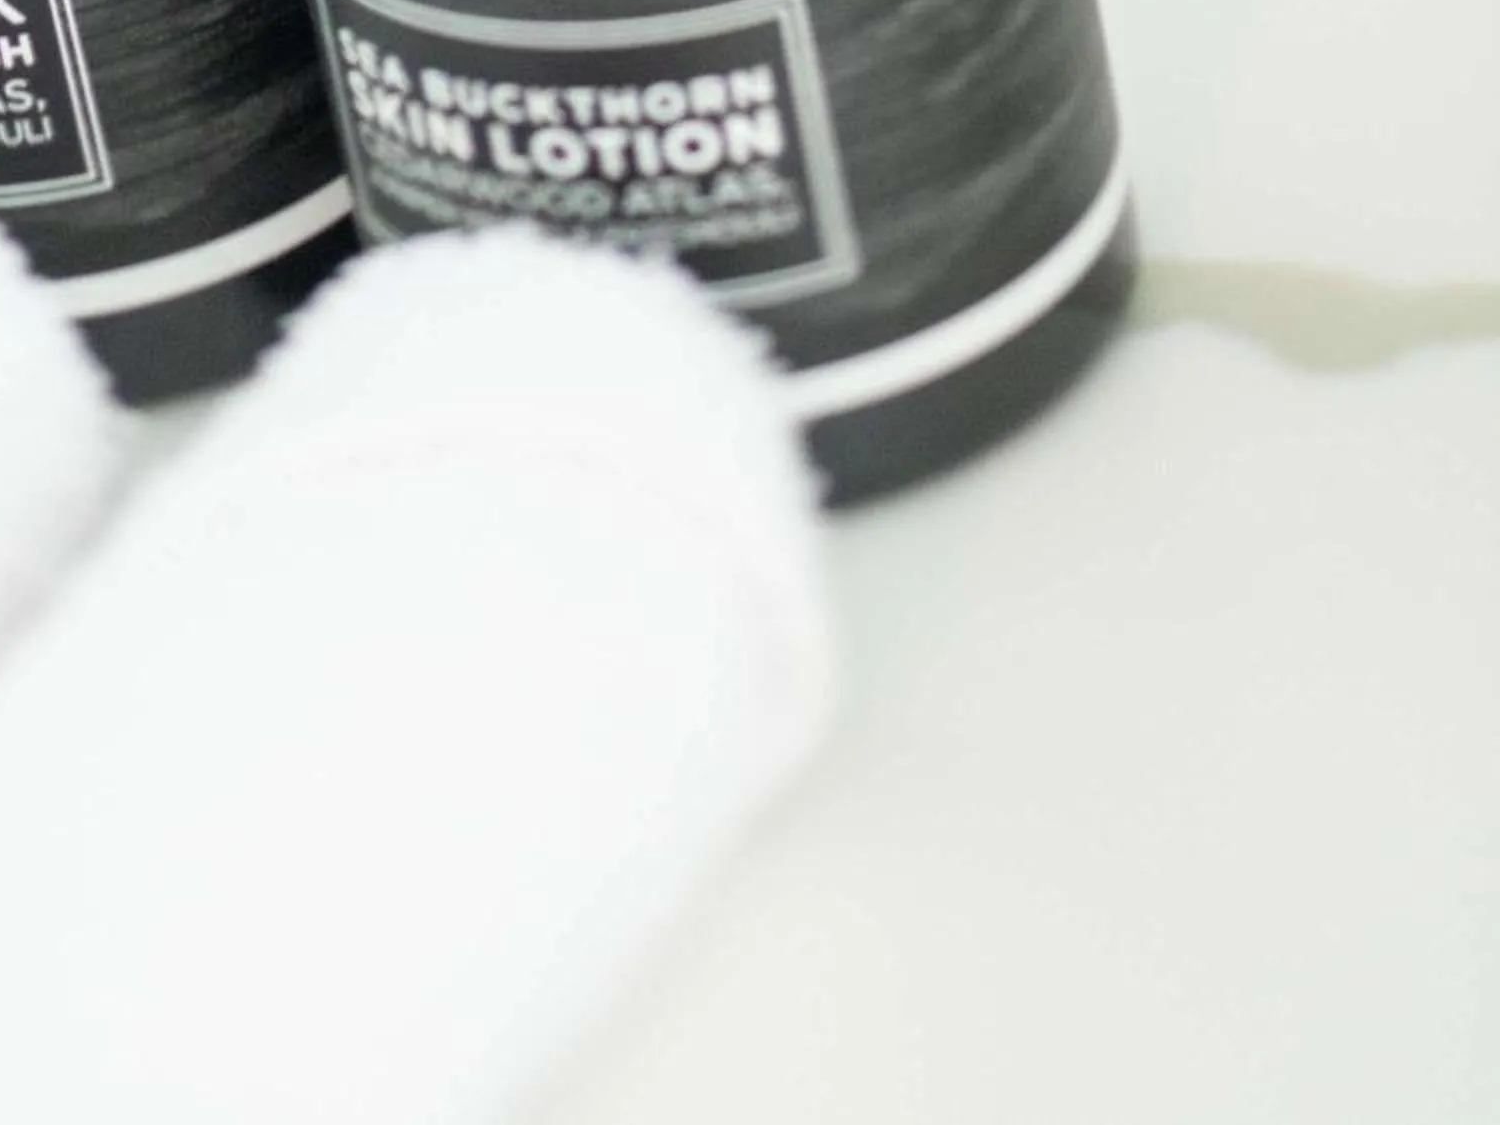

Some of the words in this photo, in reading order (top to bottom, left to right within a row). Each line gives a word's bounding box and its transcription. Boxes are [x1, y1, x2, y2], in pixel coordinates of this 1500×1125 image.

[347, 70, 477, 162] SKIN
[487, 104, 785, 178] LOTION
[419, 64, 776, 125] BUCKTHORN
